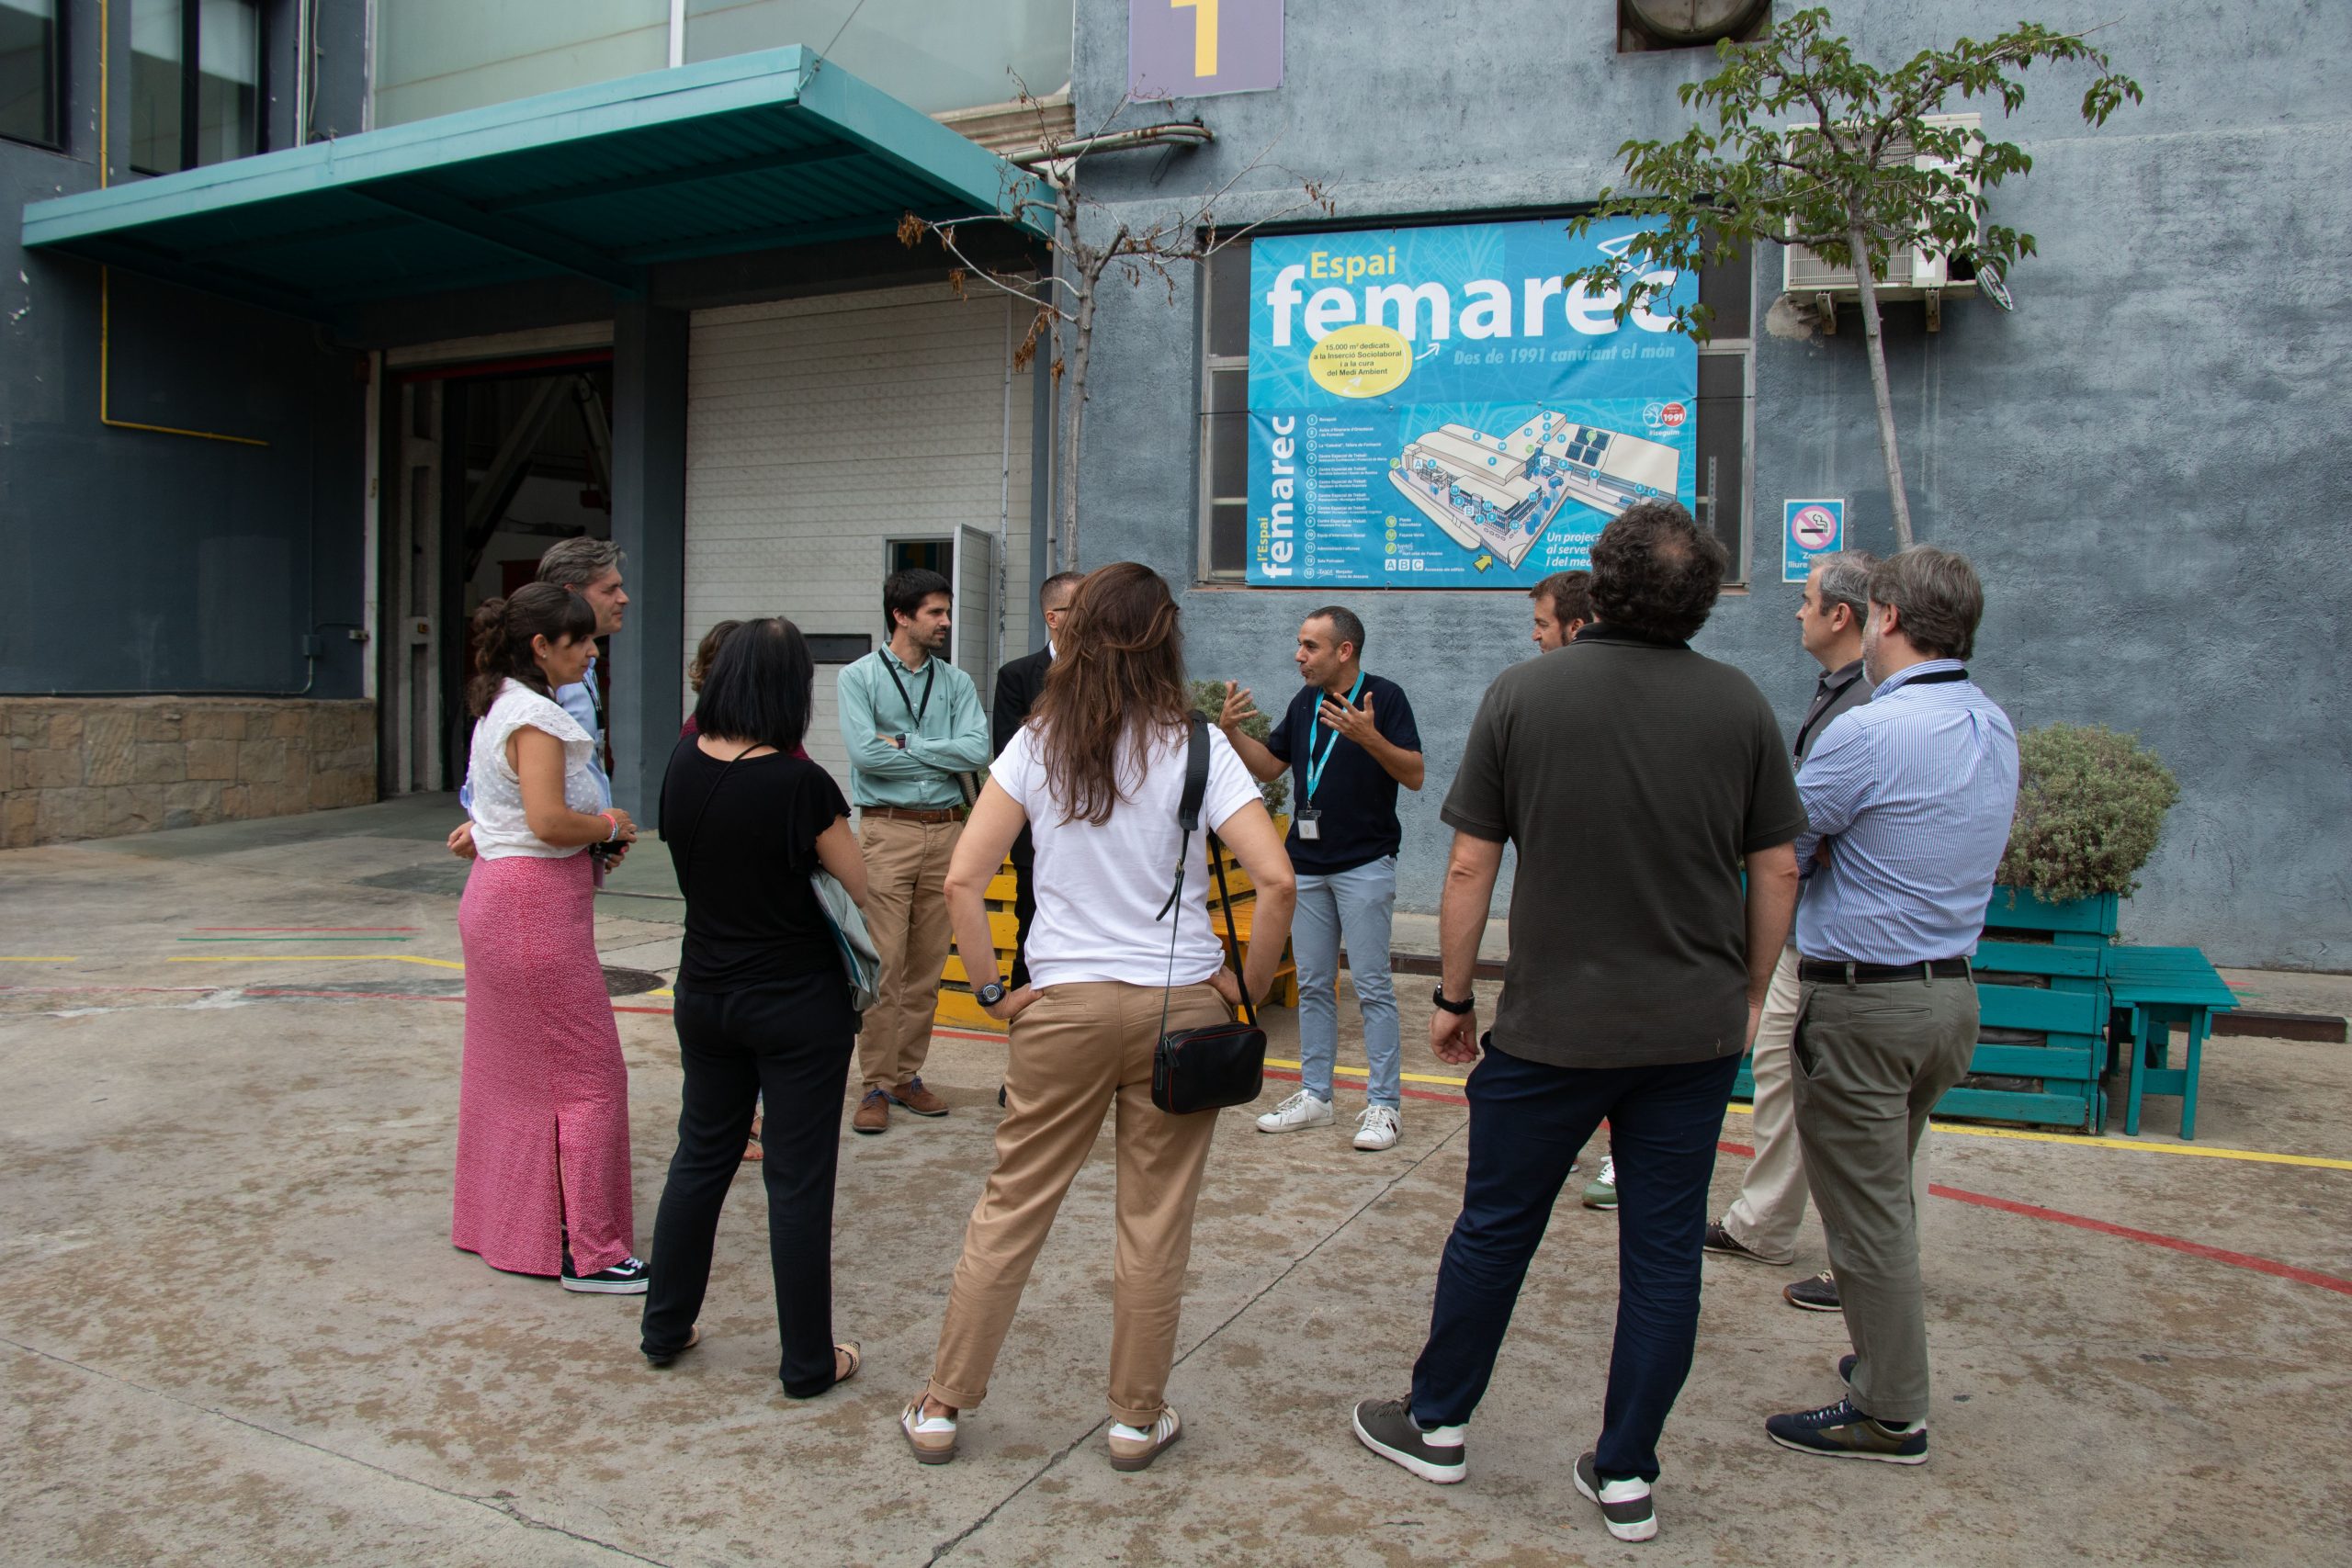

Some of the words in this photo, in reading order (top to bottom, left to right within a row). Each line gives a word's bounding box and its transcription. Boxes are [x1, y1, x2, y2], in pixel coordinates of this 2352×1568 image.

[1310, 245, 1396, 284] Espai
[1267, 264, 1678, 347] femarec
[1357, 350, 1402, 358] Sociolaboral
[1453, 350, 1480, 366] Des
[1485, 348, 1504, 364] de
[1510, 347, 1545, 364] 1991
[1551, 344, 1618, 362] canviant
[1622, 343, 1637, 359] el
[1640, 342, 1676, 358] món
[1663, 413, 1683, 423] 1991
[1261, 415, 1295, 579] femarec
[1257, 517, 1271, 562] l'Espai
[1546, 532, 1561, 542] Un
[1545, 544, 1557, 555] al
[1558, 544, 1590, 555] servei
[1386, 560, 1395, 570] A
[1400, 560, 1408, 570] B
[1414, 560, 1422, 570] C
[1545, 557, 1550, 567] i
[1551, 556, 1568, 567] del
[1787, 560, 1808, 569] lliure
